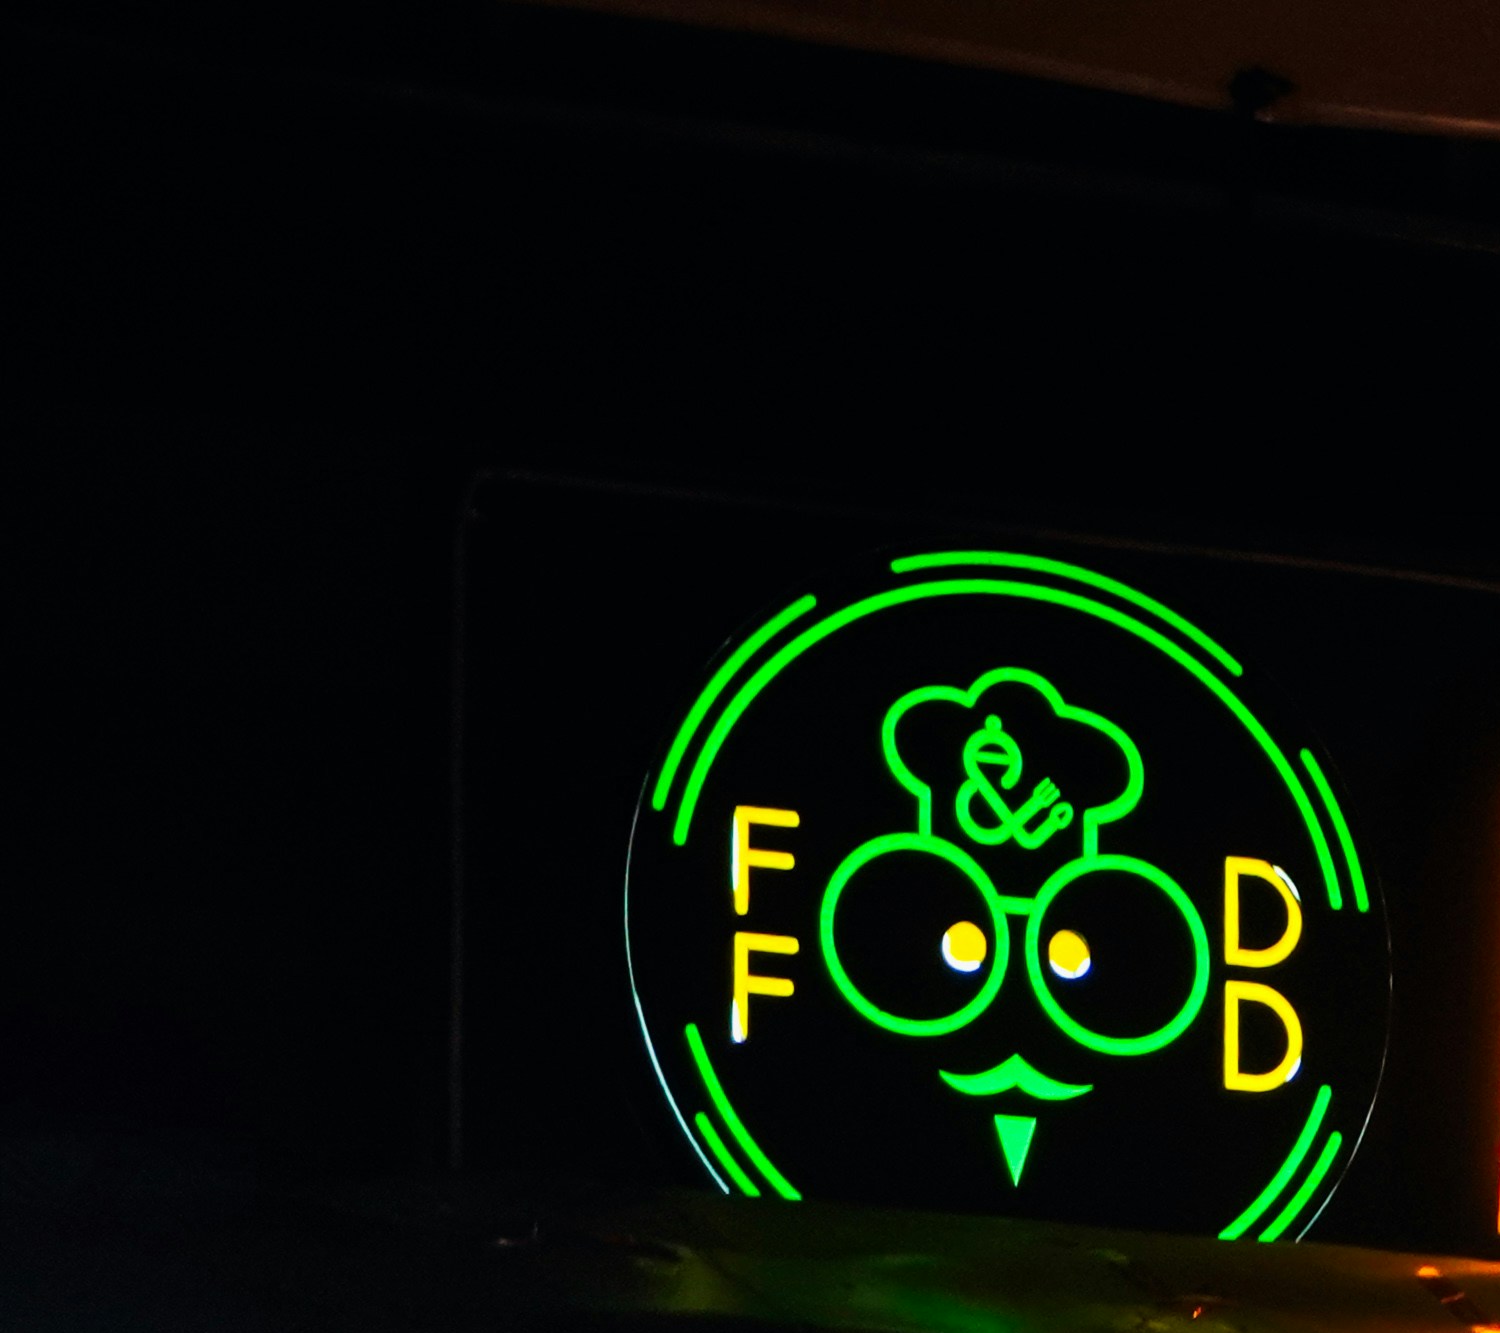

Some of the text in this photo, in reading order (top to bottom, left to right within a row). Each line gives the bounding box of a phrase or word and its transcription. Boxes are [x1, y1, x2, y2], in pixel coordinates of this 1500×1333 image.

[732, 805, 800, 916] F
[1224, 856, 1303, 968] D
[731, 933, 800, 1044] F
[1224, 981, 1303, 1092] D
